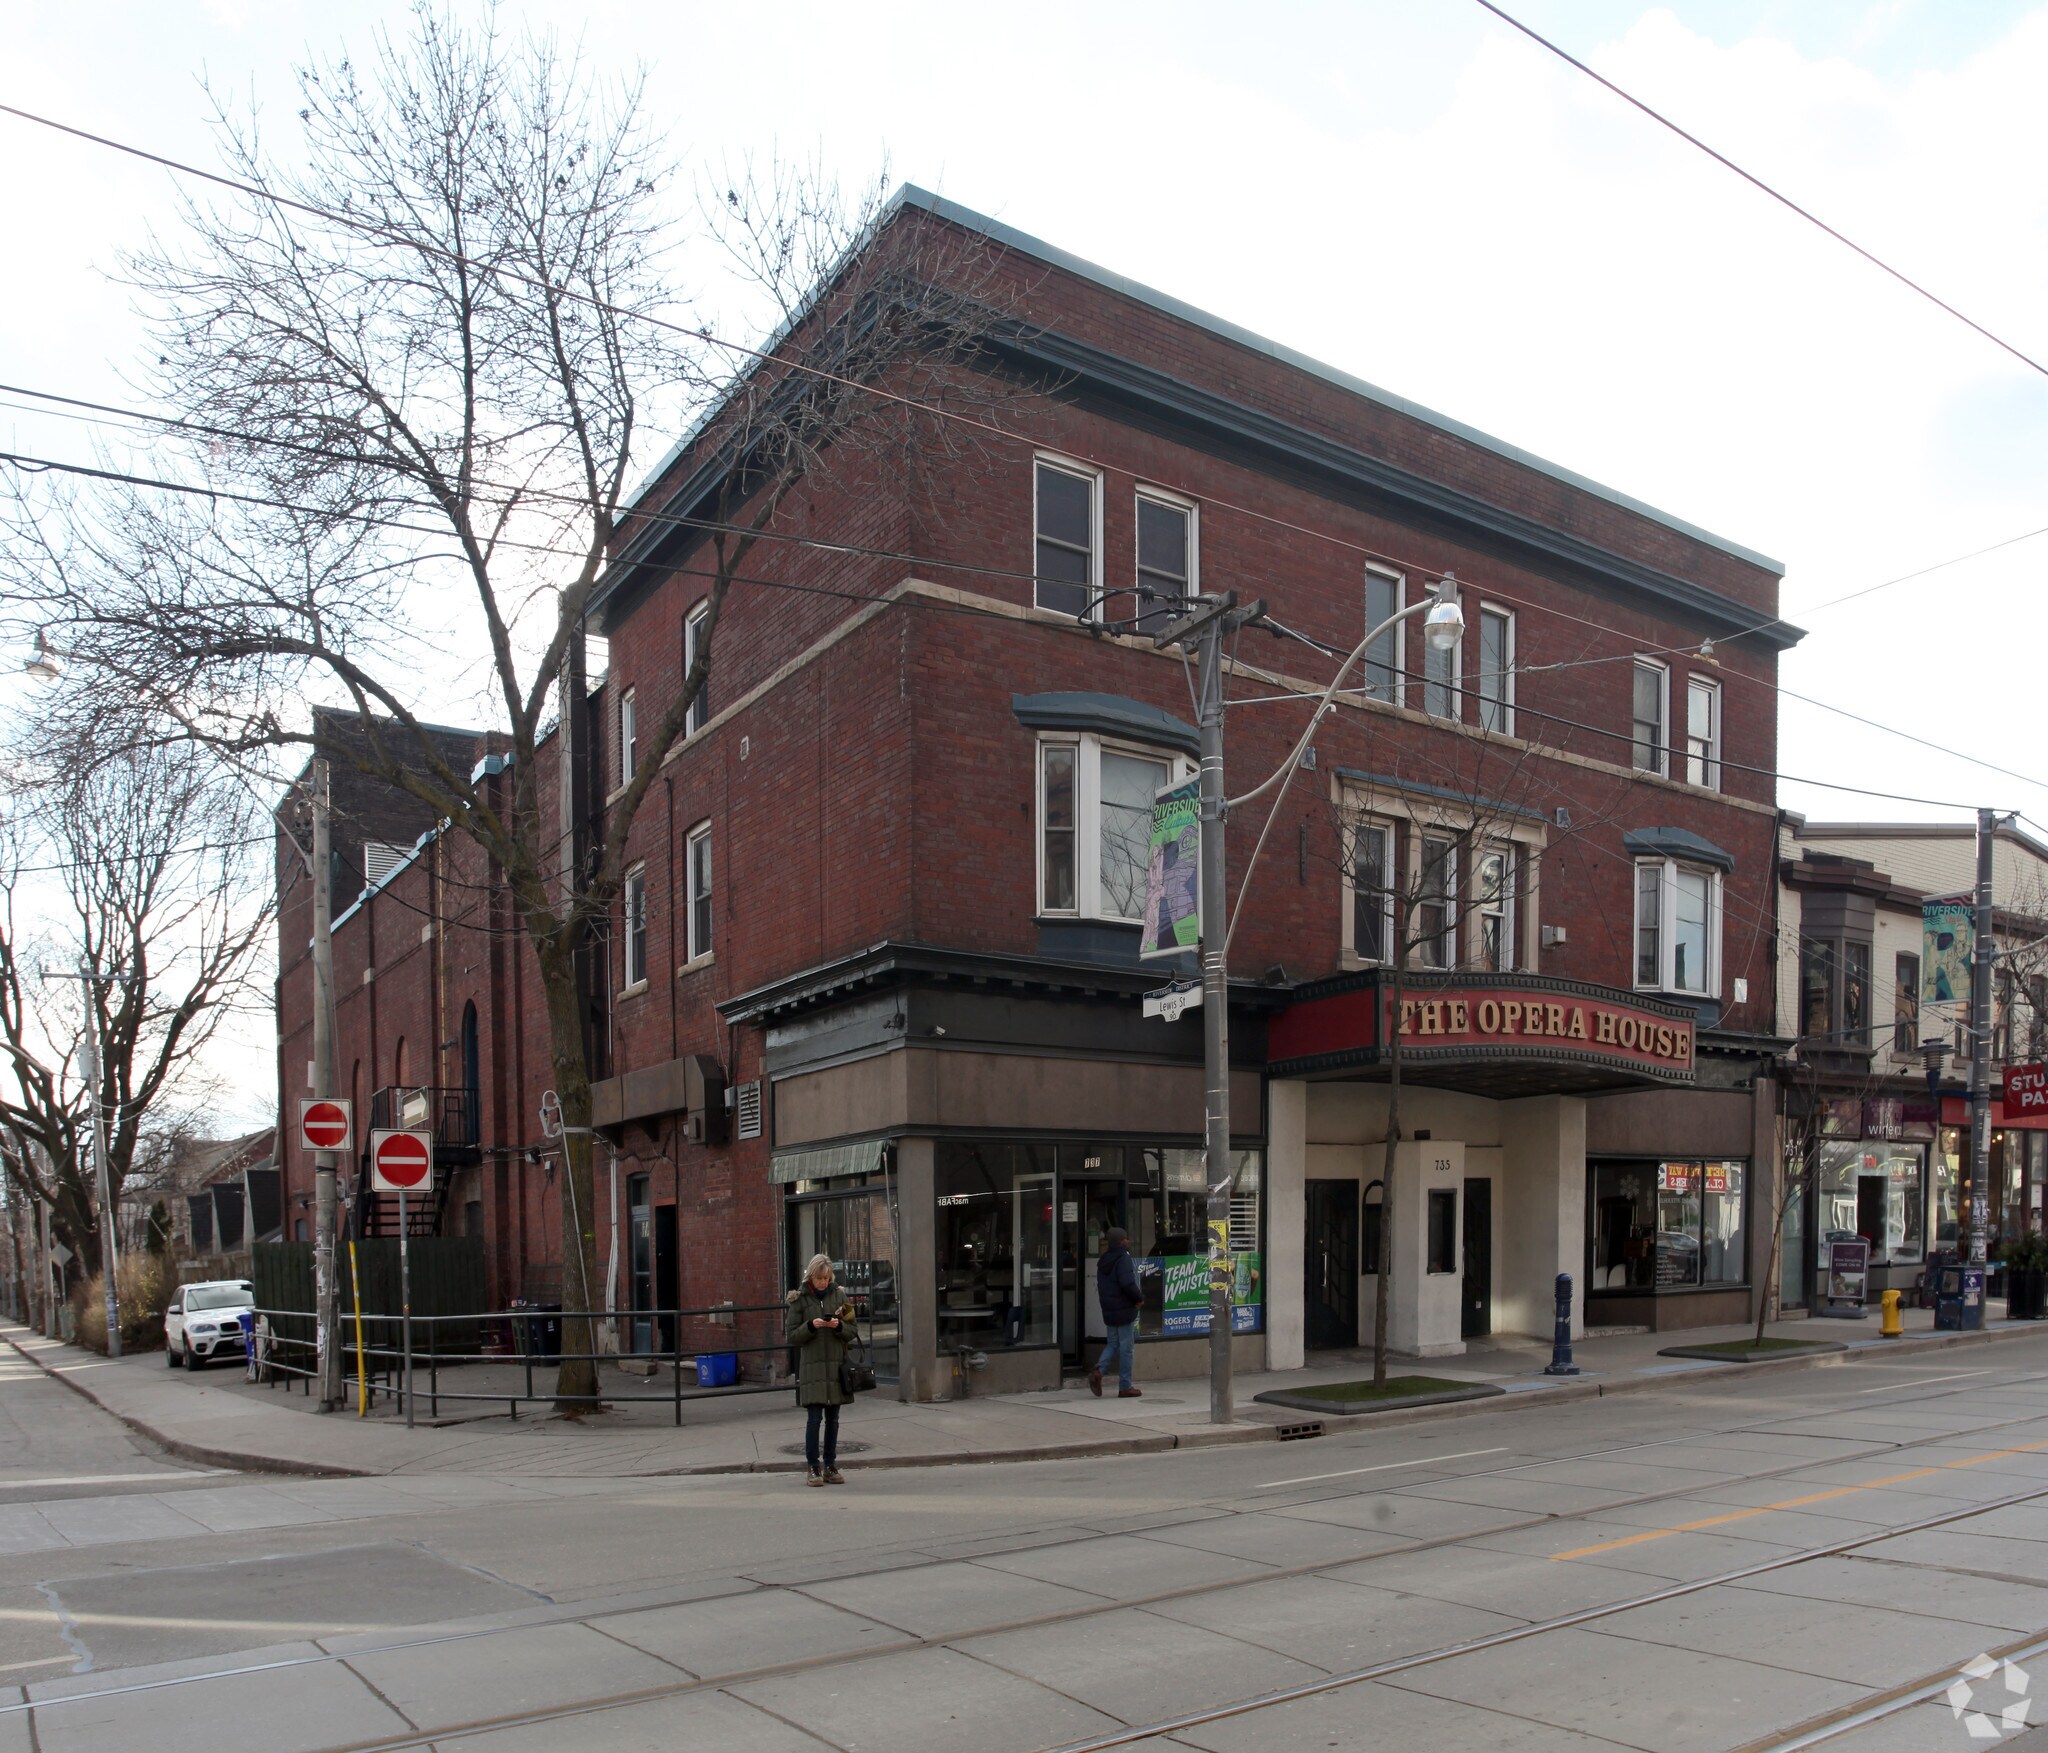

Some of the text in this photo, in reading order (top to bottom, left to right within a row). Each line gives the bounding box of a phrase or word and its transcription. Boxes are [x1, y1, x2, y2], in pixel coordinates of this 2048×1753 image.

[1154, 798, 1199, 819] RIVERSIDE
[1164, 813, 1195, 830] Culture
[1922, 905, 1973, 916] RIVERSIDE
[1152, 983, 1193, 997] RIVERSIDE DISTRICT
[1159, 996, 1186, 1012] Lewis St
[1400, 1000, 1691, 1060] THE OPERA HOUSE
[1084, 1157, 1101, 1169] 737
[1434, 1159, 1451, 1171] 735
[1165, 1260, 1198, 1282] TEAM
[1165, 1271, 1210, 1303] WHISTL
[1165, 1316, 1191, 1326] ROGERS
